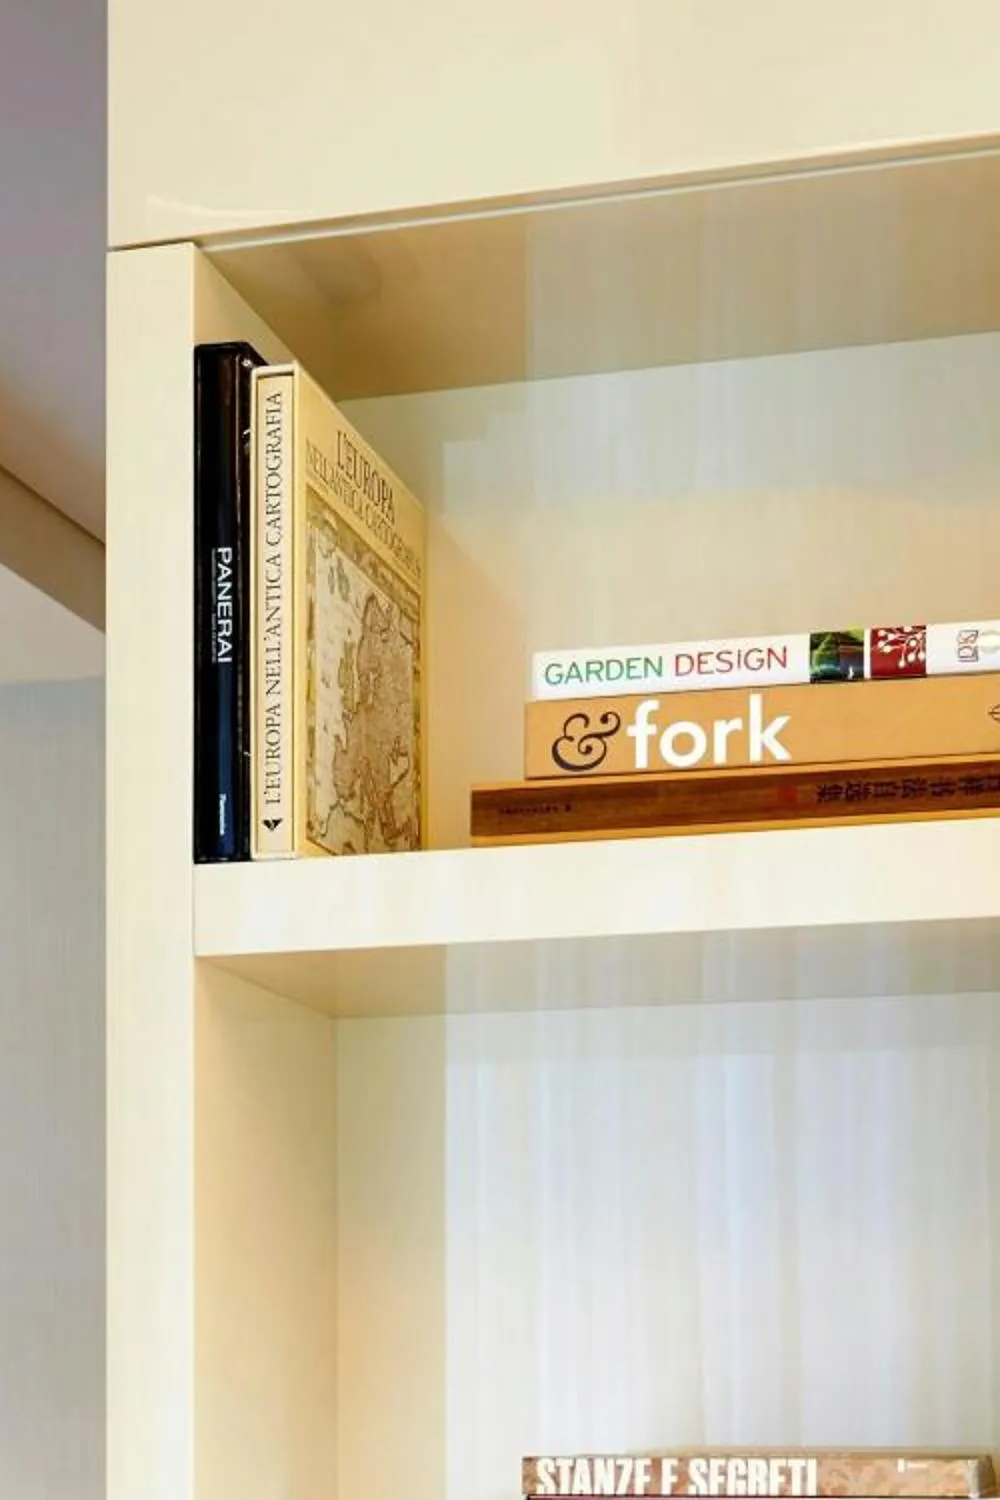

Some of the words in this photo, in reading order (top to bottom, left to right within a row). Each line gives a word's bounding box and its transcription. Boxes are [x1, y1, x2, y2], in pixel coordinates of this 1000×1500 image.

[264, 391, 282, 547] CARTOGRAFIA
[217, 547, 233, 663] PANERAI
[263, 553, 282, 697] NELL'ANTICA
[545, 655, 664, 686] GARDEN
[675, 646, 788, 677] DESIGN
[263, 703, 282, 804] L'EUROPA
[551, 711, 621, 772] &
[626, 693, 792, 769] fork
